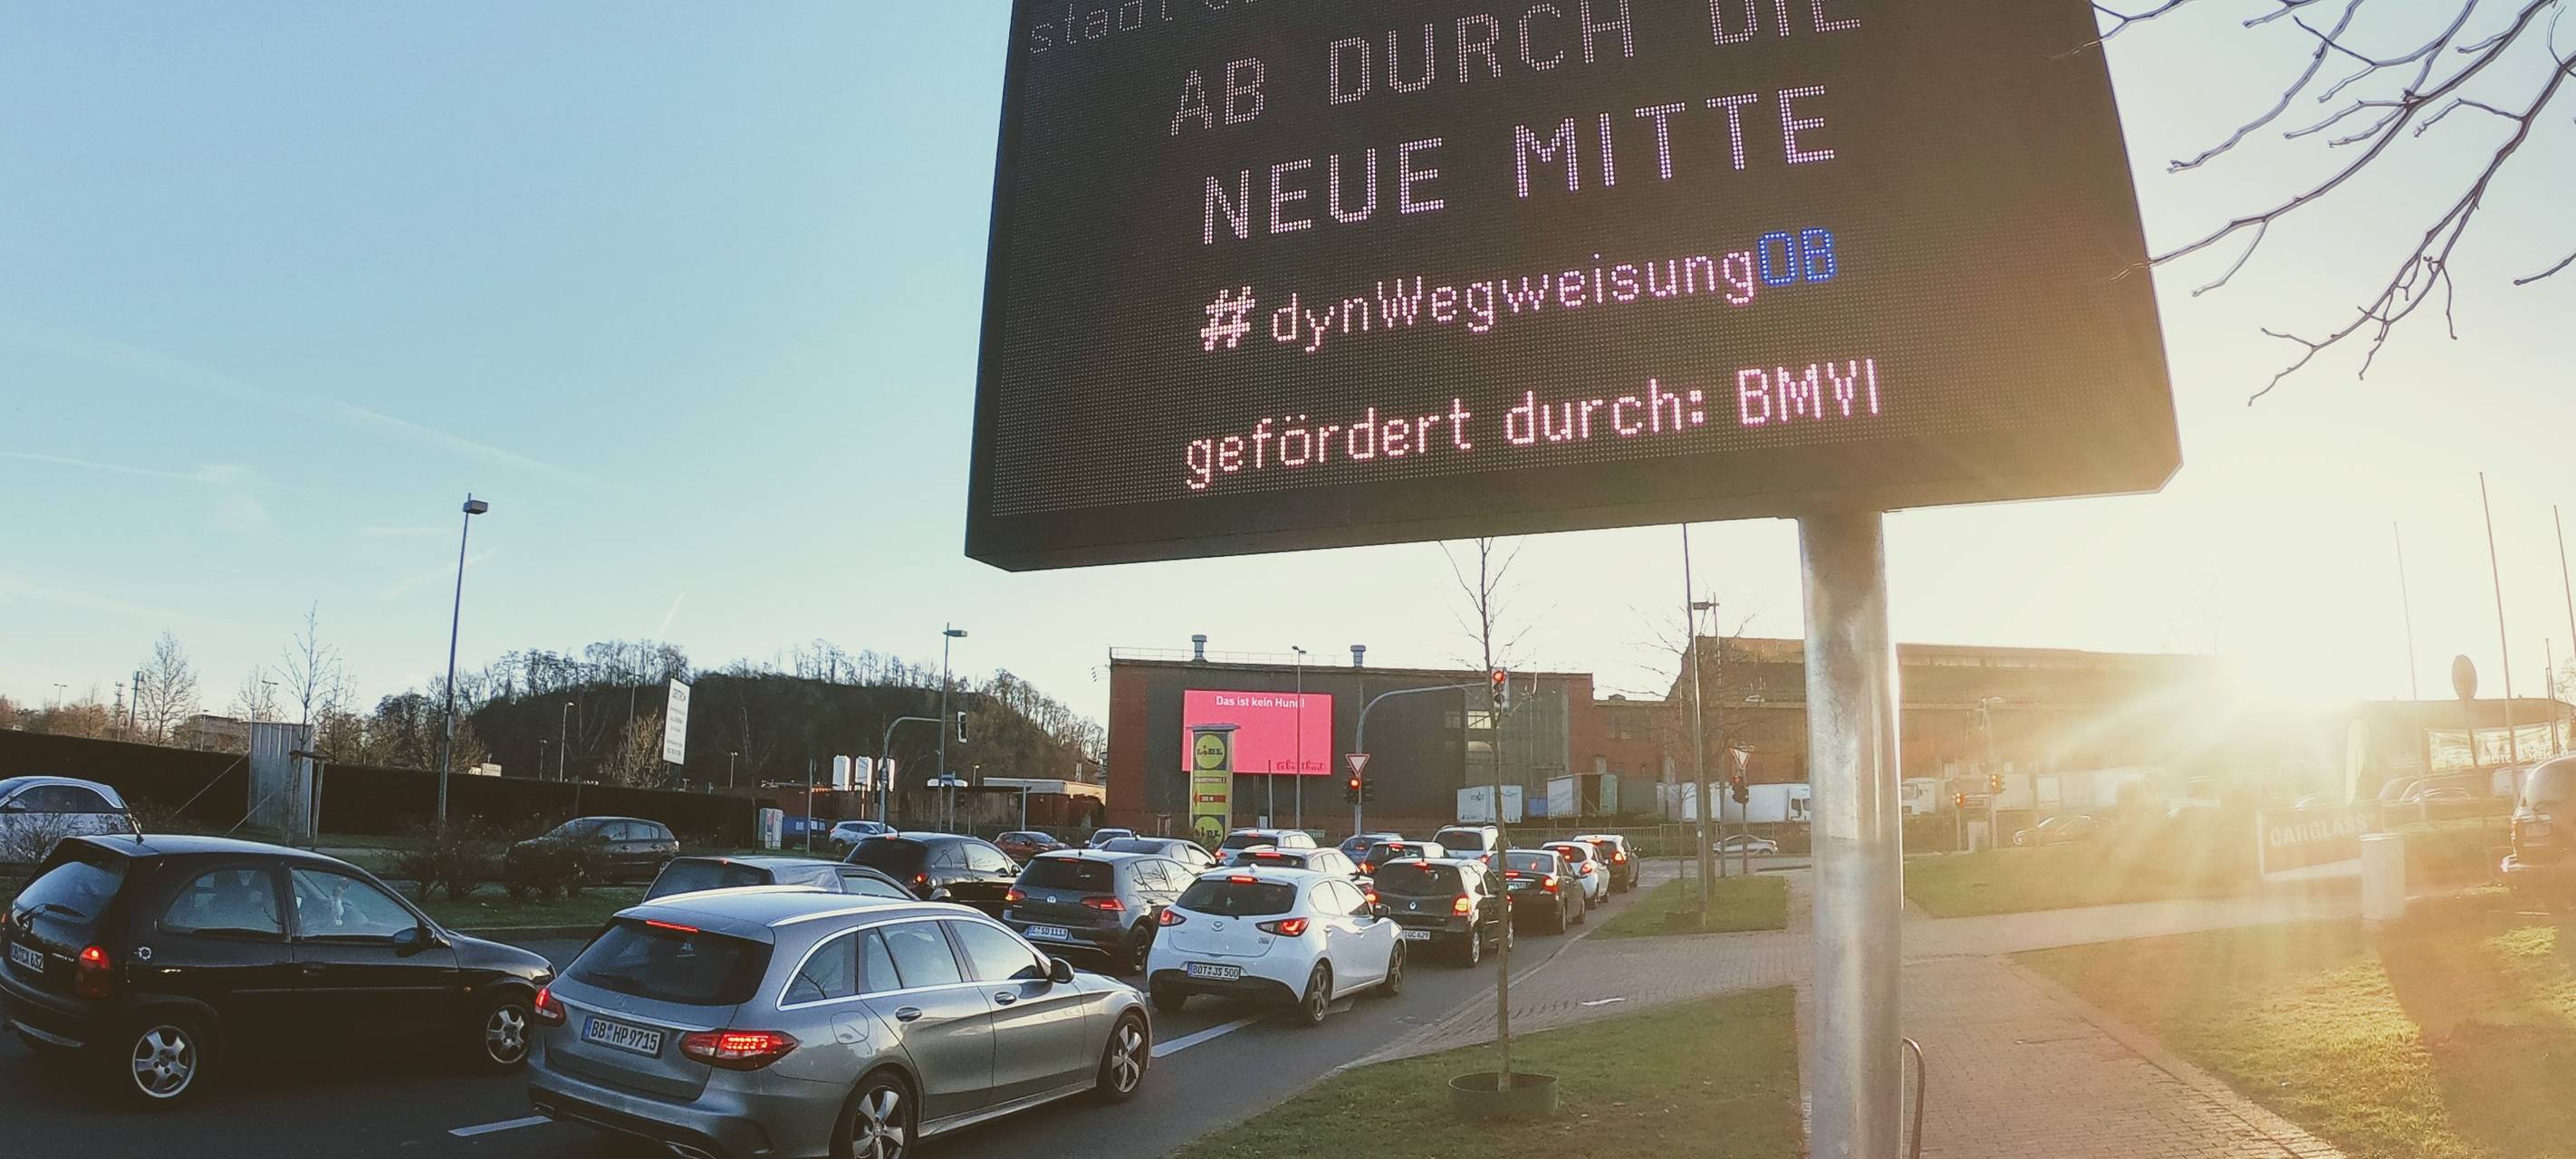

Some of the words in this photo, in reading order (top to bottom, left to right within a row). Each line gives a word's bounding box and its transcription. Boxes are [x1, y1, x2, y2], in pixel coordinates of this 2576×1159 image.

[1170, 57, 1264, 136] AB
[1329, 0, 1634, 106] DURCH
[1204, 137, 1445, 245] NEUE
[1514, 85, 1835, 198] MITTE
[1186, 397, 1473, 490] gefördert
[1504, 378, 1706, 446] durch:
[1216, 696, 1235, 706] Das
[1237, 697, 1249, 707] ist
[1252, 697, 1273, 707] kein
